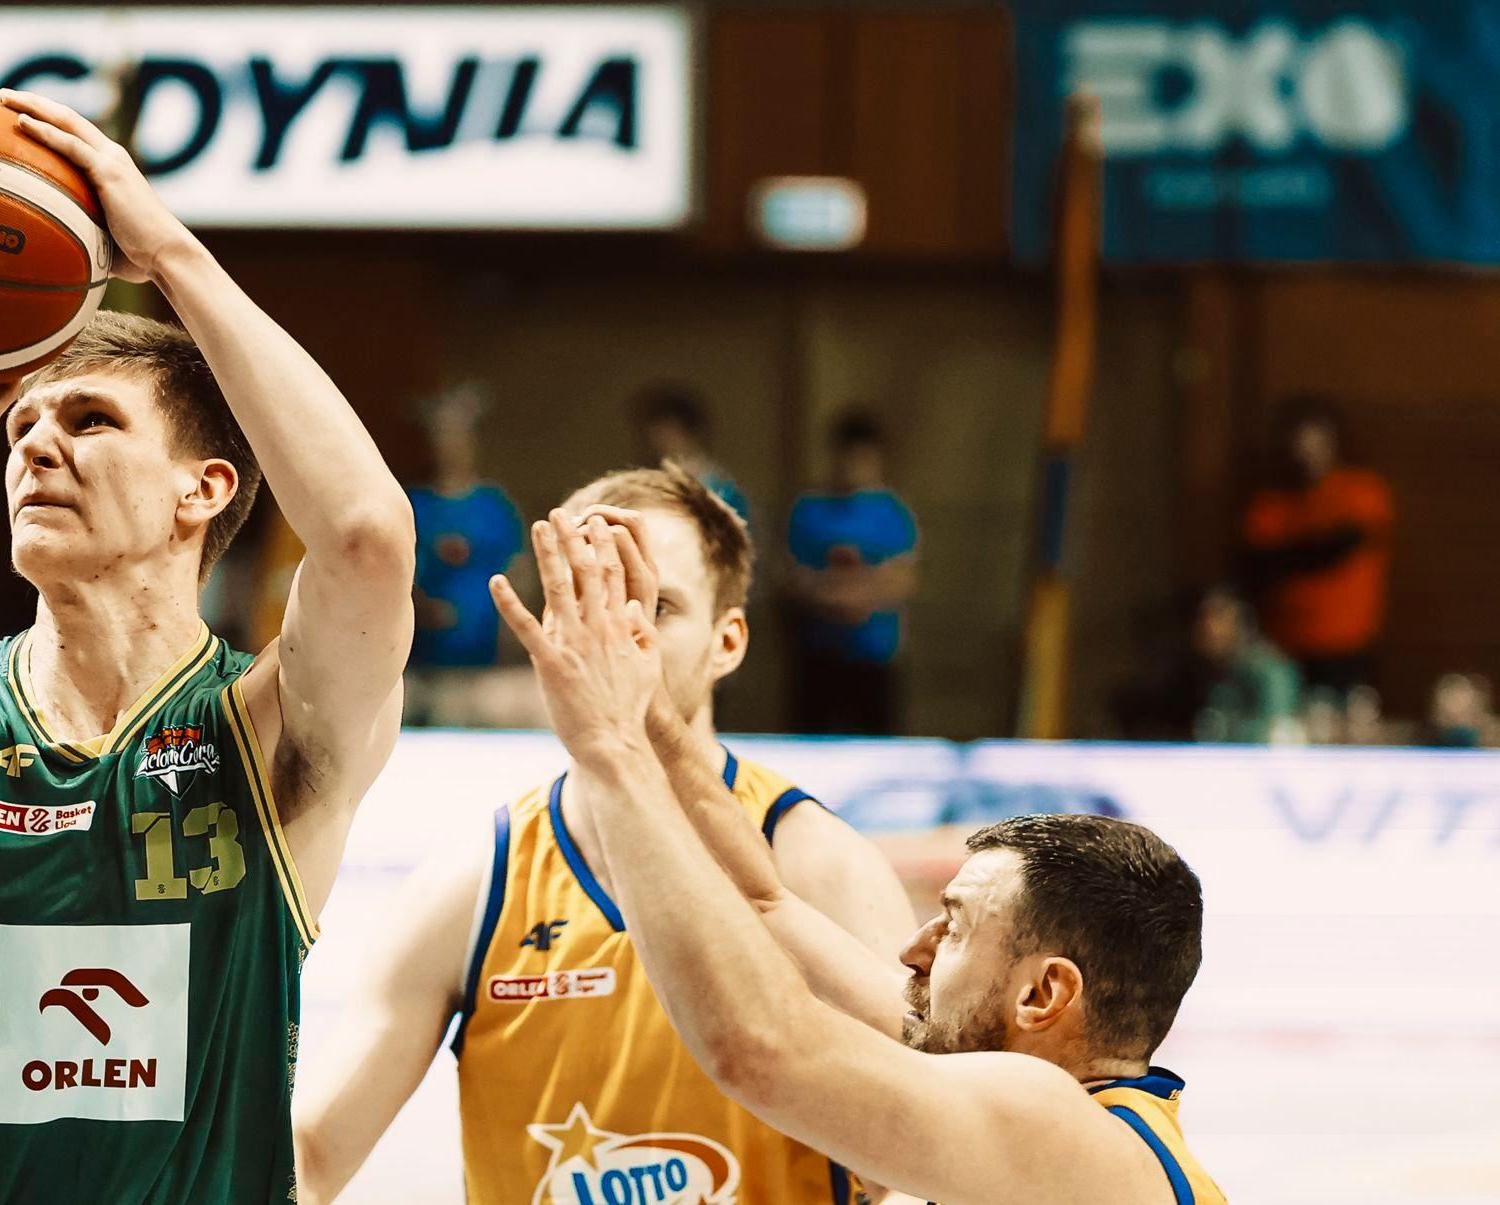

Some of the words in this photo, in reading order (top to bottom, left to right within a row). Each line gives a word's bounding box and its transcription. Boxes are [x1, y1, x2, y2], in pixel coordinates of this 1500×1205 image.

[55, 805, 92, 820] Basket
[1270, 784, 1500, 844] VIT
[131, 800, 247, 901] 13
[21, 1058, 158, 1092] ORLEN
[572, 1158, 688, 1205] LOTTO
